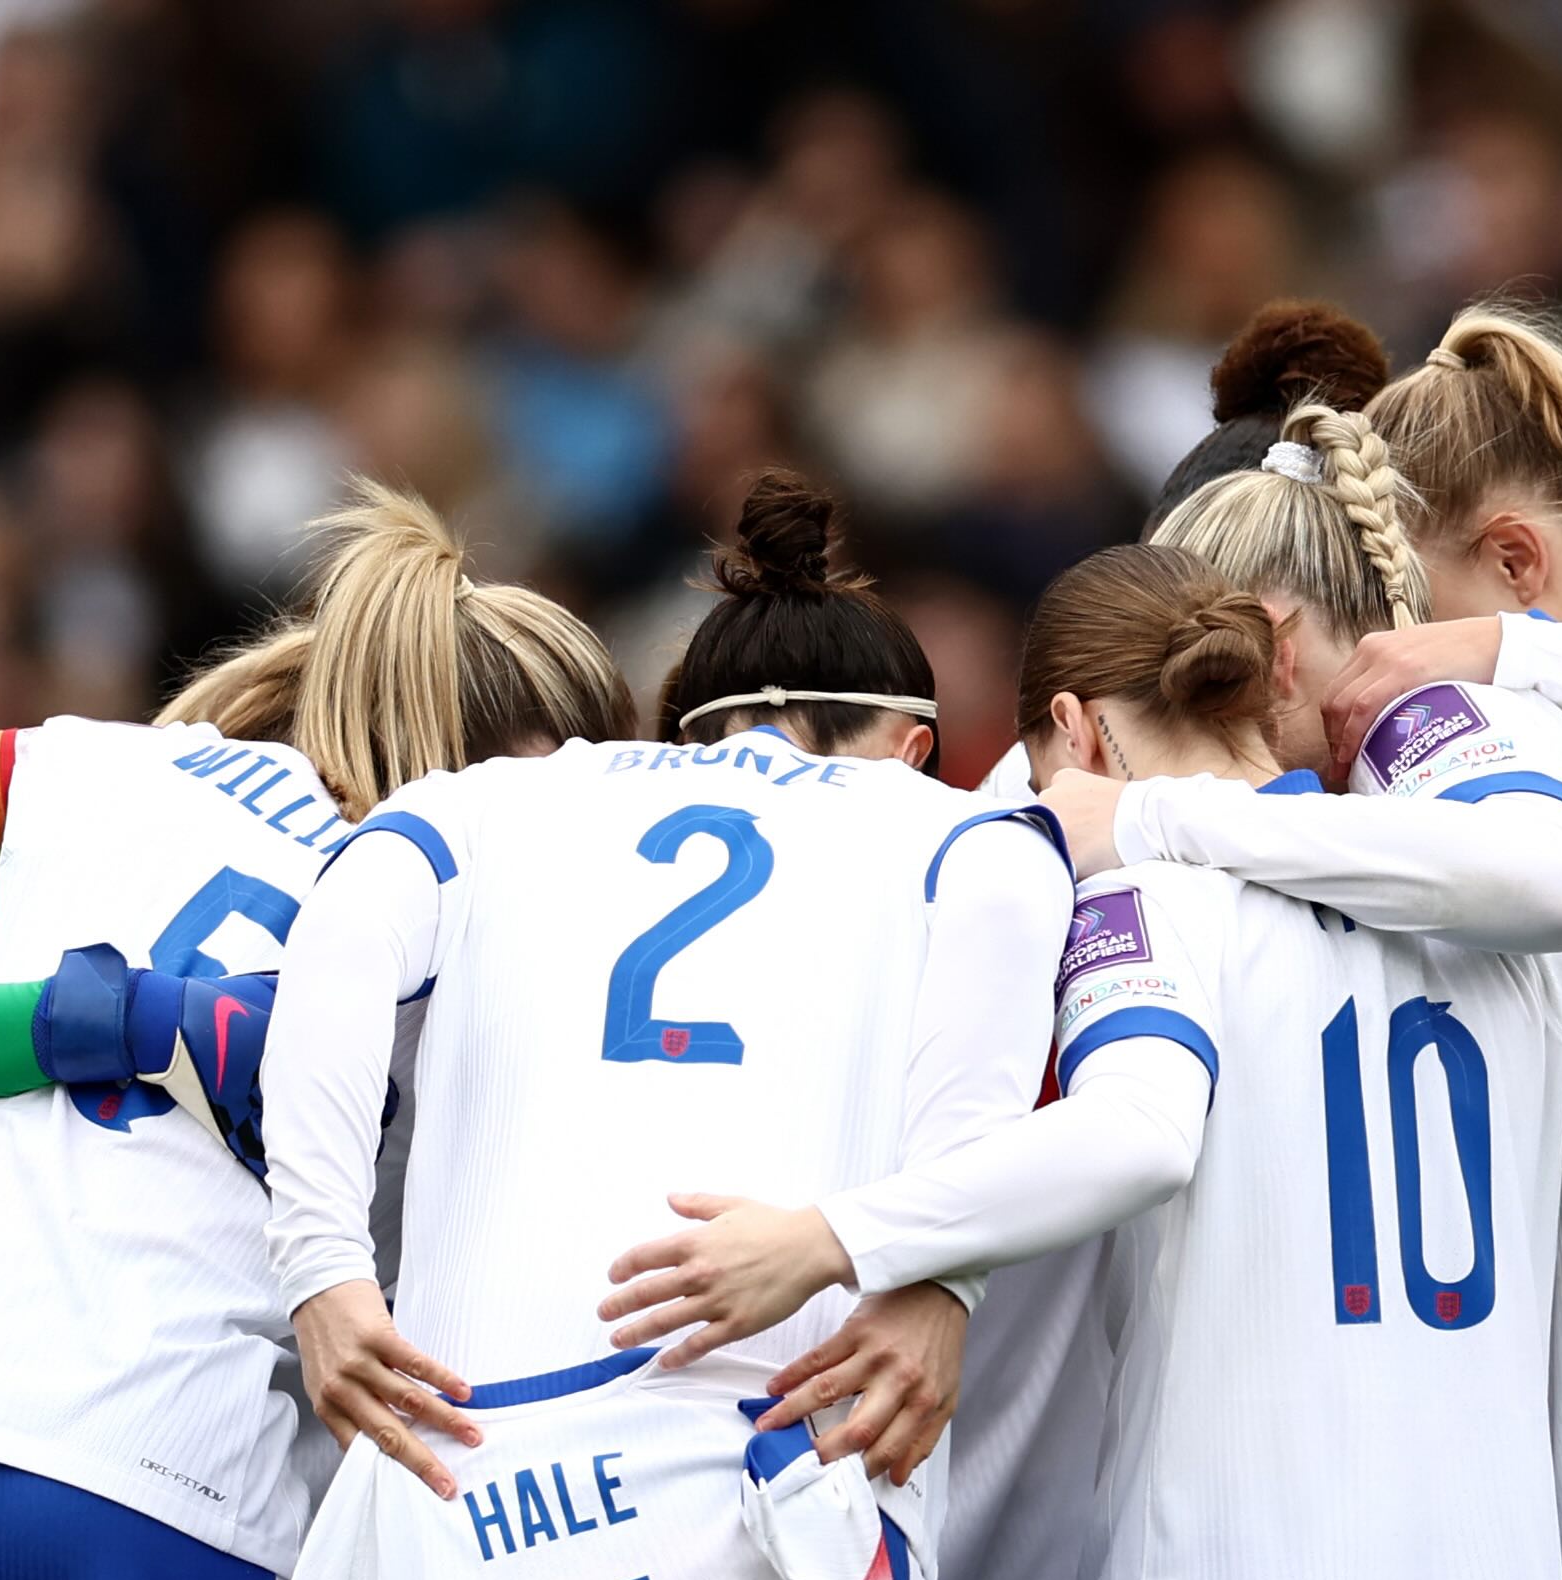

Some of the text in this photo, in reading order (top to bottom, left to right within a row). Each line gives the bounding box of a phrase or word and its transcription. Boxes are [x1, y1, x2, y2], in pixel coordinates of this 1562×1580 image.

[1387, 712, 1466, 774] EUROPEAN
[1392, 717, 1473, 782] QUALIFIERS
[602, 804, 775, 1066] 2
[1062, 932, 1134, 969] ROPEAN
[1322, 995, 1497, 1332] 10
[464, 1452, 638, 1561] HALE
